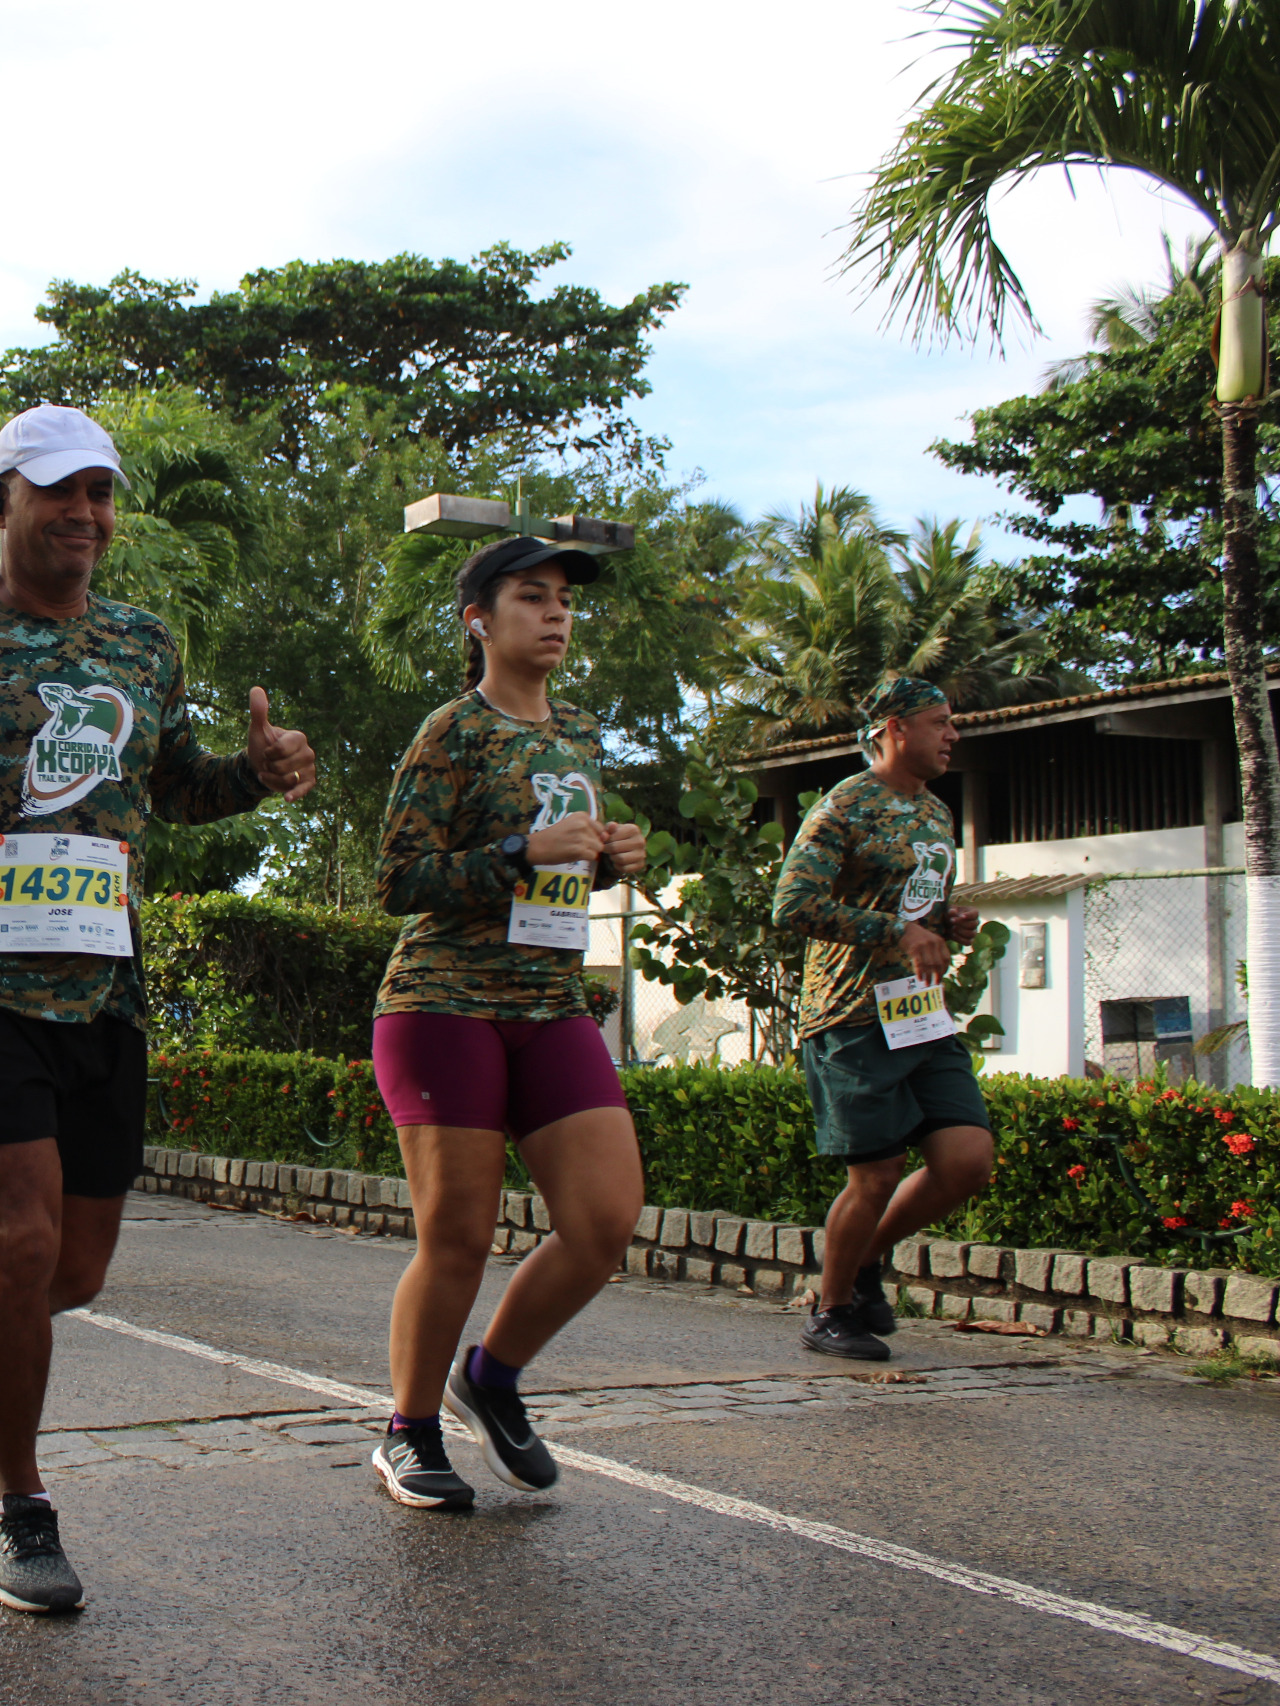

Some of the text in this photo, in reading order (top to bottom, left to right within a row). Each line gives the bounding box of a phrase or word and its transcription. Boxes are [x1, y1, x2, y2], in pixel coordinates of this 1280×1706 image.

[58, 740, 115, 757] CORRIDA DA
[57, 753, 120, 779] COPPA
[38, 774, 71, 783] TRAIL RUN
[1, 867, 111, 905] 14373
[523, 872, 590, 906] 1407
[48, 908, 74, 916] JOSE
